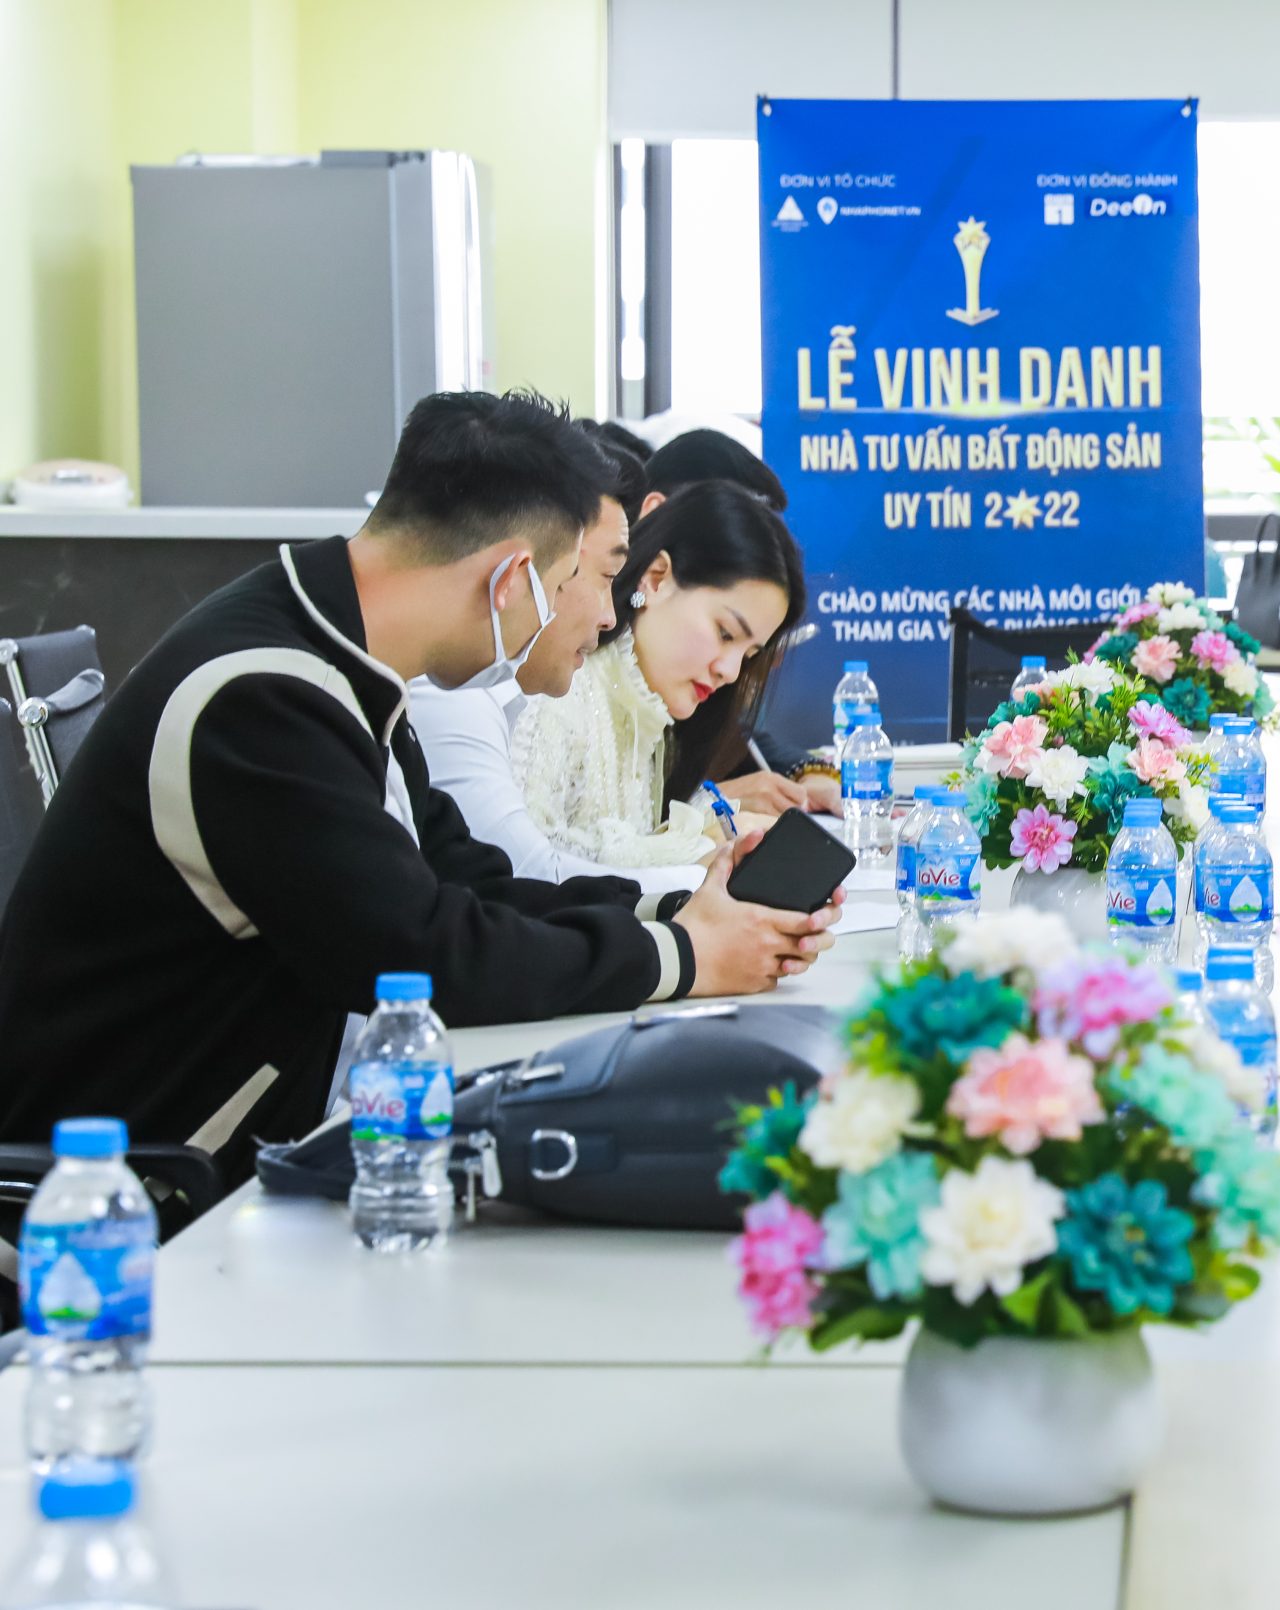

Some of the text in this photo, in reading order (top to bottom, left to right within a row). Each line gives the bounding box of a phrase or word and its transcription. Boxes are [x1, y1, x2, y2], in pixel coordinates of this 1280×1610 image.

[798, 325, 1162, 410] LỄ VINH DANH
[800, 422, 1161, 477] NHÀ TƯ VẤN BẤT ĐỘNG SẢN
[883, 492, 921, 528] UY
[925, 486, 971, 528] TÍN
[817, 586, 878, 614] CHÀO
[880, 585, 950, 619] MỪNG
[954, 585, 995, 612] CÁC
[999, 584, 1046, 611] NHÀ
[1050, 583, 1092, 611] MÔI
[831, 619, 894, 642] THAM
[897, 619, 936, 642] GIA
